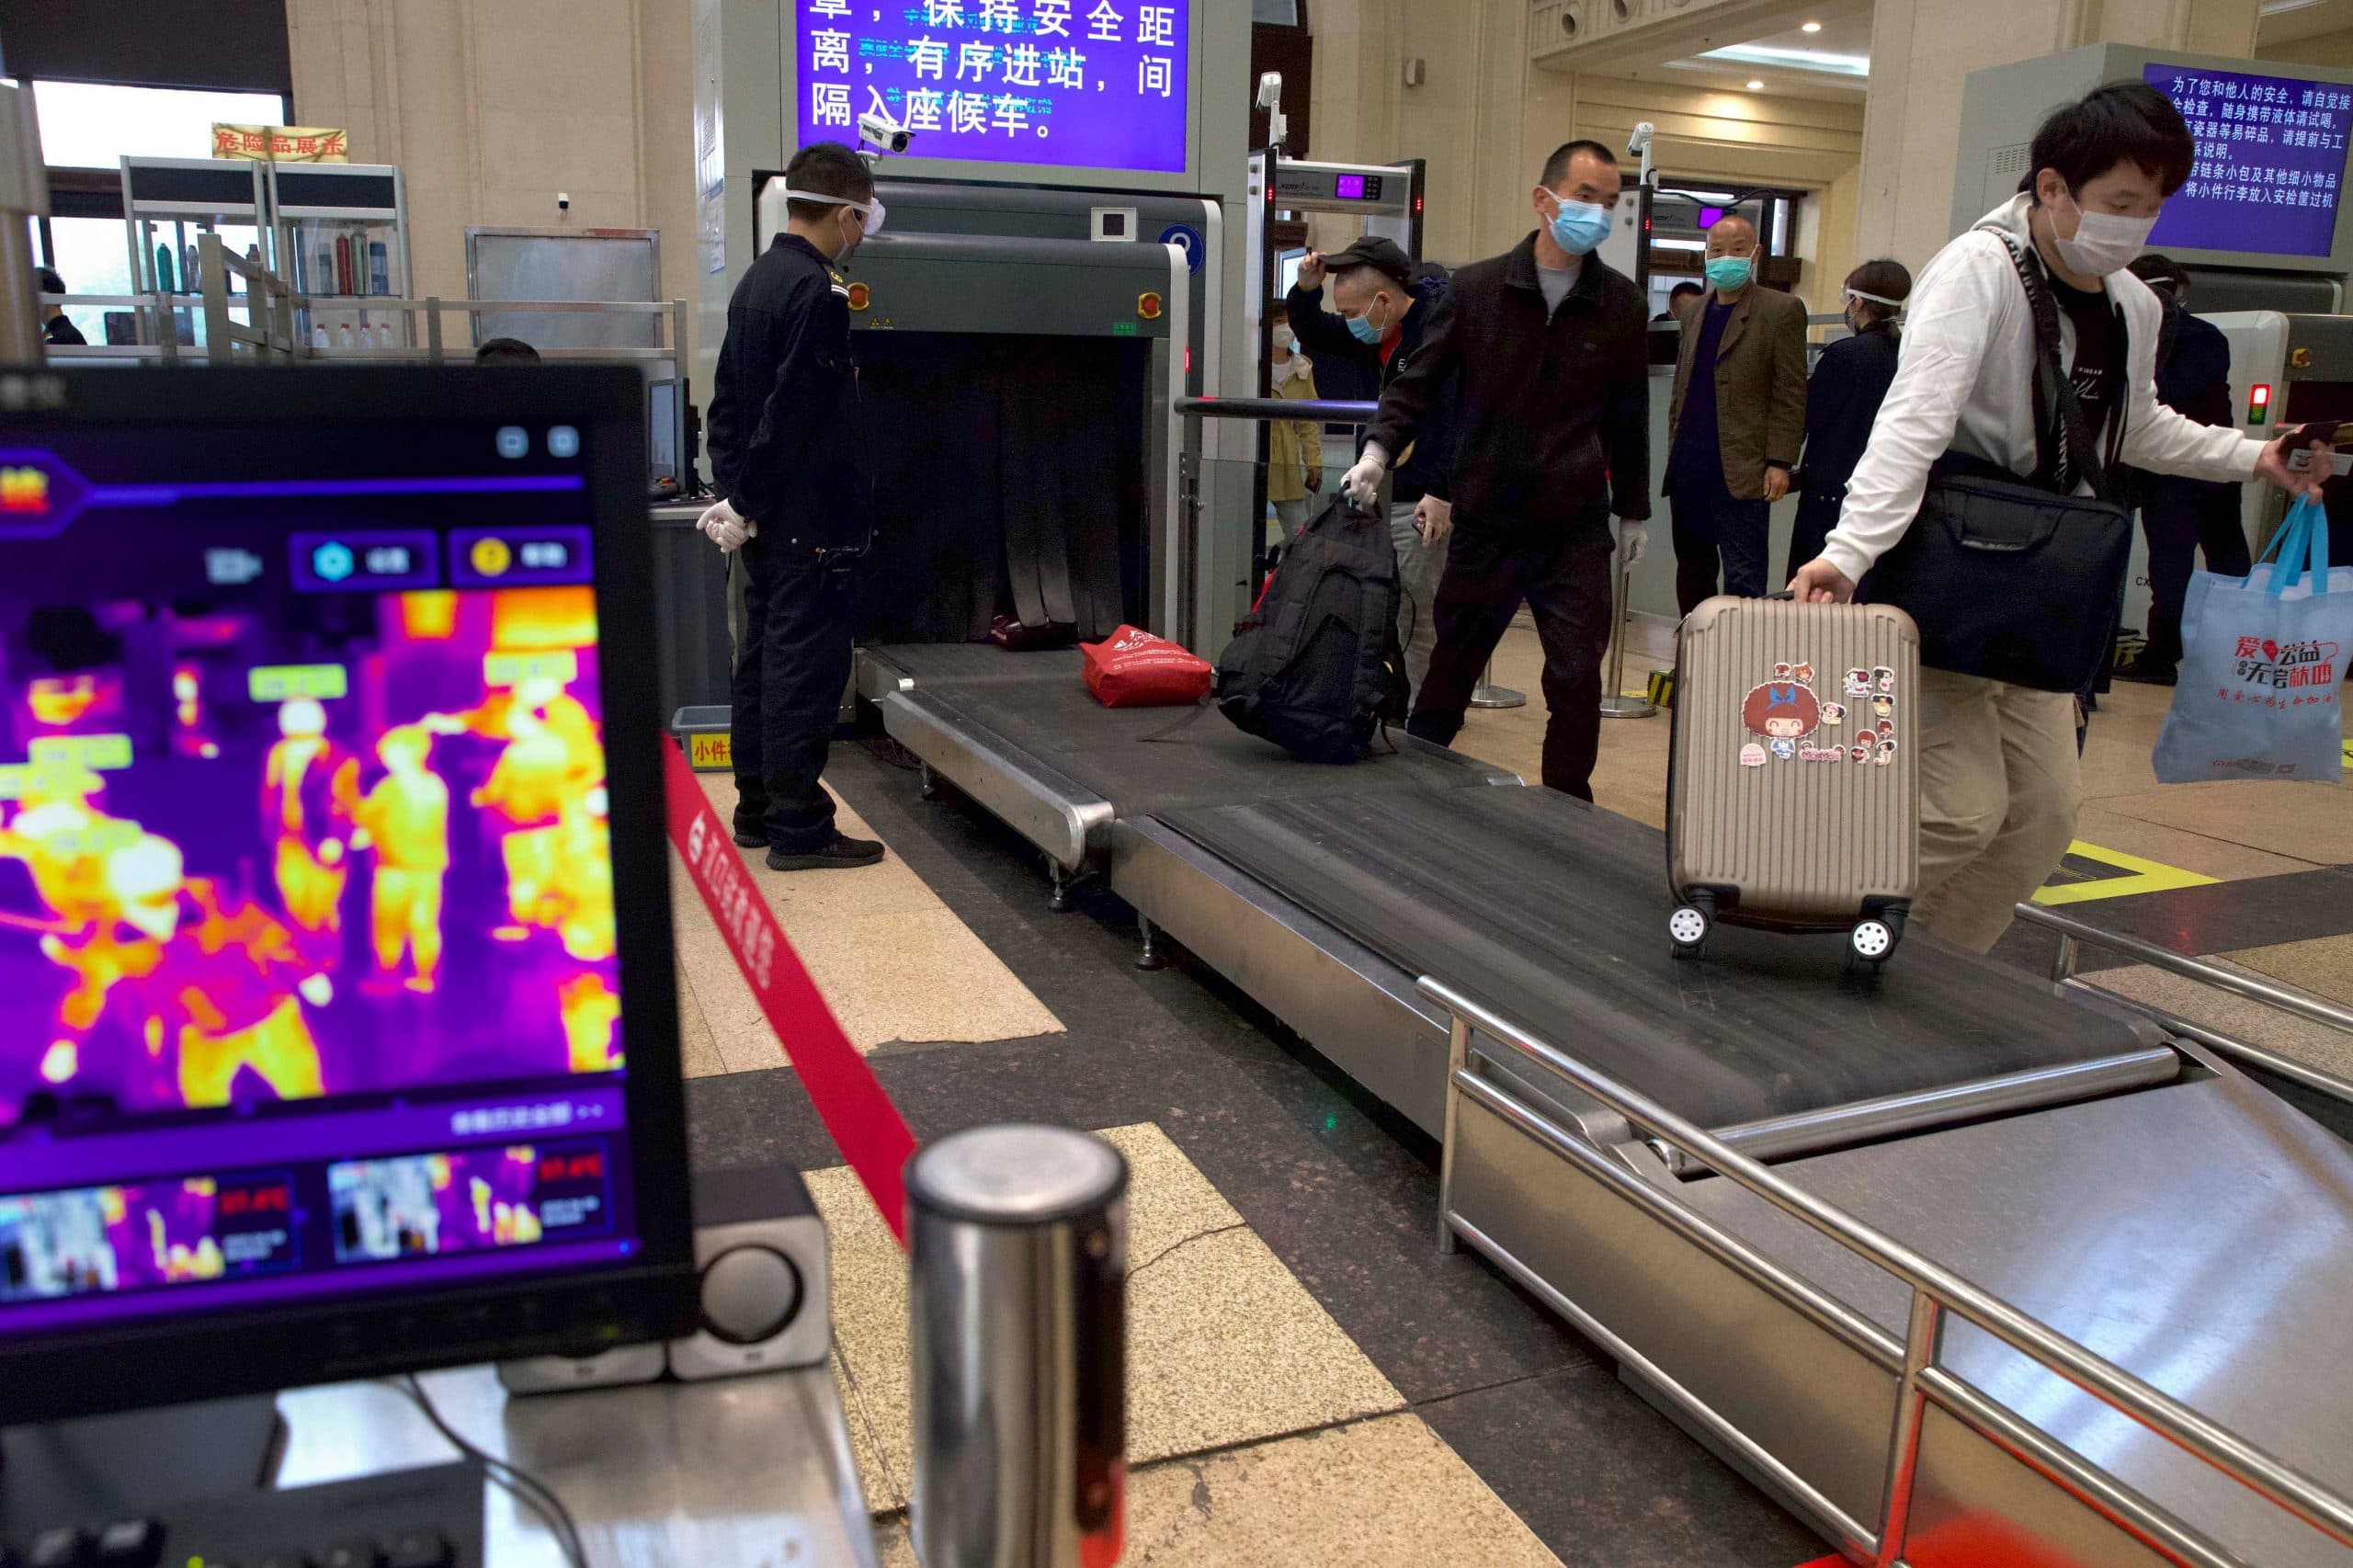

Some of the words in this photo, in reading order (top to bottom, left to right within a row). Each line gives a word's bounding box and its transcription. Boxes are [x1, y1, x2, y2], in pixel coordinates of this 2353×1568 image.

[2171, 75, 2352, 110] 为了您和他人的安全，请自觉接
[812, 83, 1049, 138] 隔入座候车。
[215, 131, 347, 156] 危险品展示
[695, 739, 732, 762] 小件
